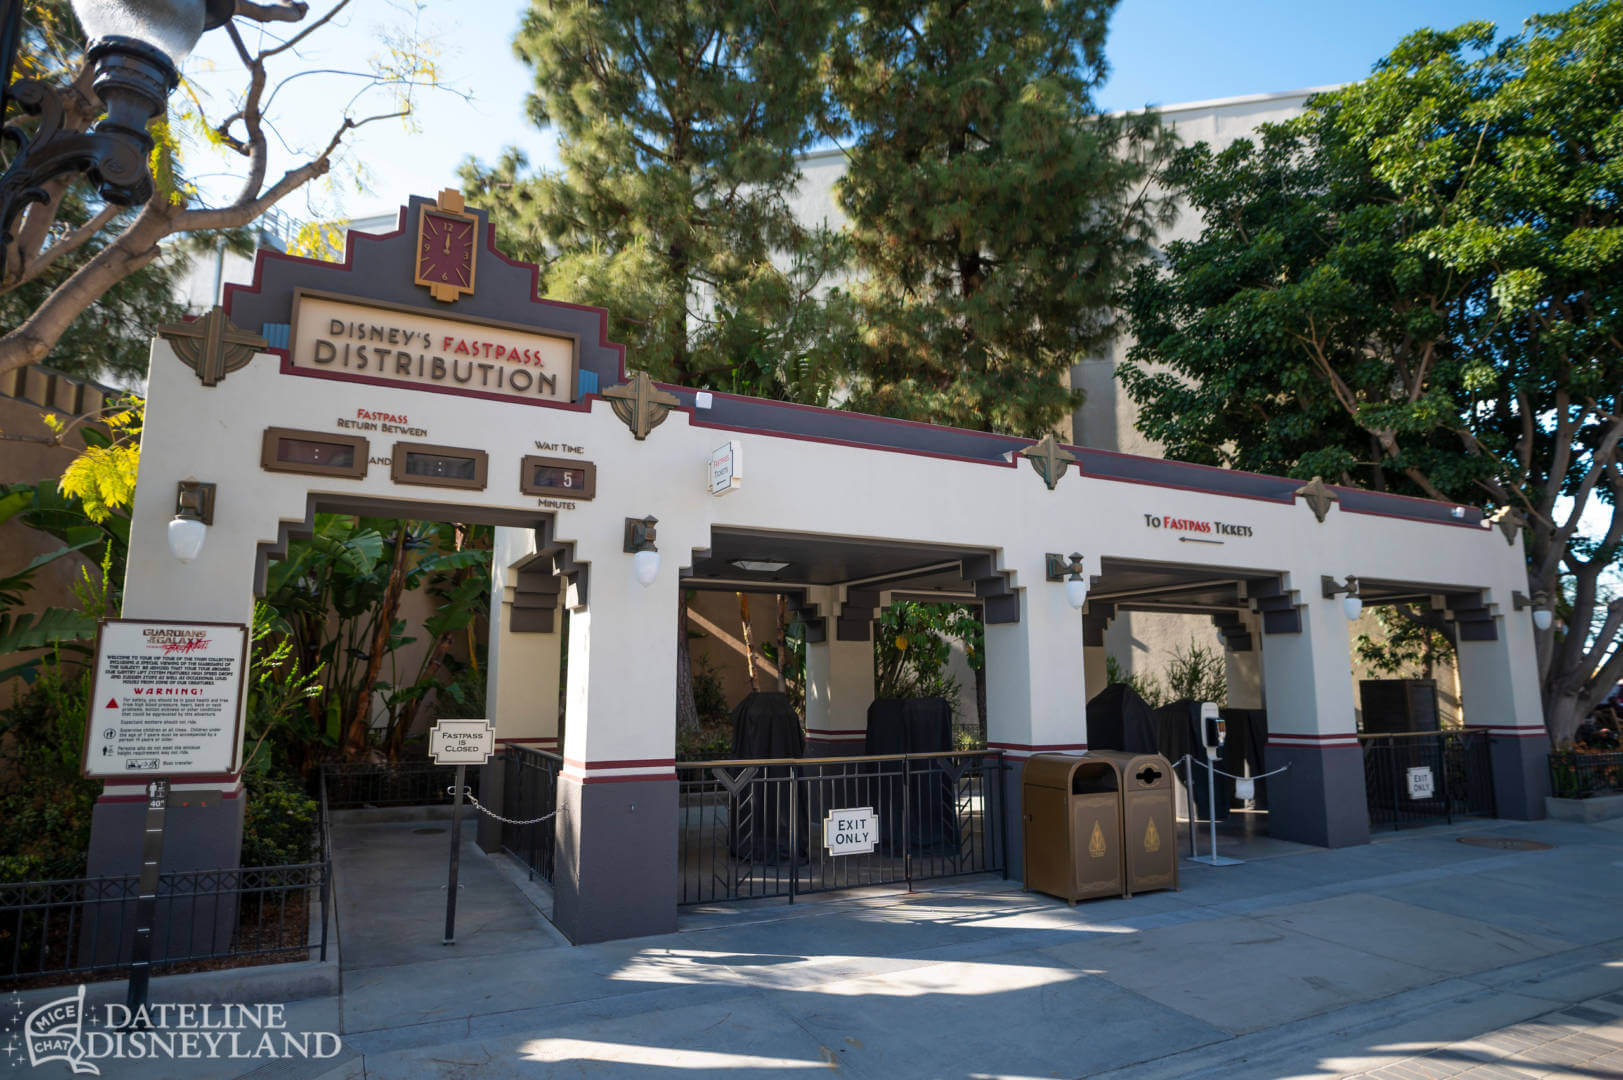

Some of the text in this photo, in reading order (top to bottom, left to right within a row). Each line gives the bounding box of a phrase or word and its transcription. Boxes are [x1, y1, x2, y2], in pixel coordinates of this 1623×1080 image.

[443, 222, 453, 232] 12
[424, 243, 430, 252] 9
[441, 272, 448, 281] 6
[330, 319, 541, 367] DISNEY'S FASTPASS
[314, 338, 557, 396] DISTRIBUTION
[357, 408, 408, 424] FASTPASS
[337, 418, 427, 437] RETURN BETWEEN
[534, 440, 558, 451] WAIT
[369, 456, 392, 466] AND
[563, 472, 572, 487] 5
[538, 499, 575, 510] MINUTES
[1163, 516, 1211, 533] FASTPASS
[1214, 522, 1253, 537] TICKETS
[838, 819, 866, 831] EXIT
[836, 832, 868, 844] ONLY
